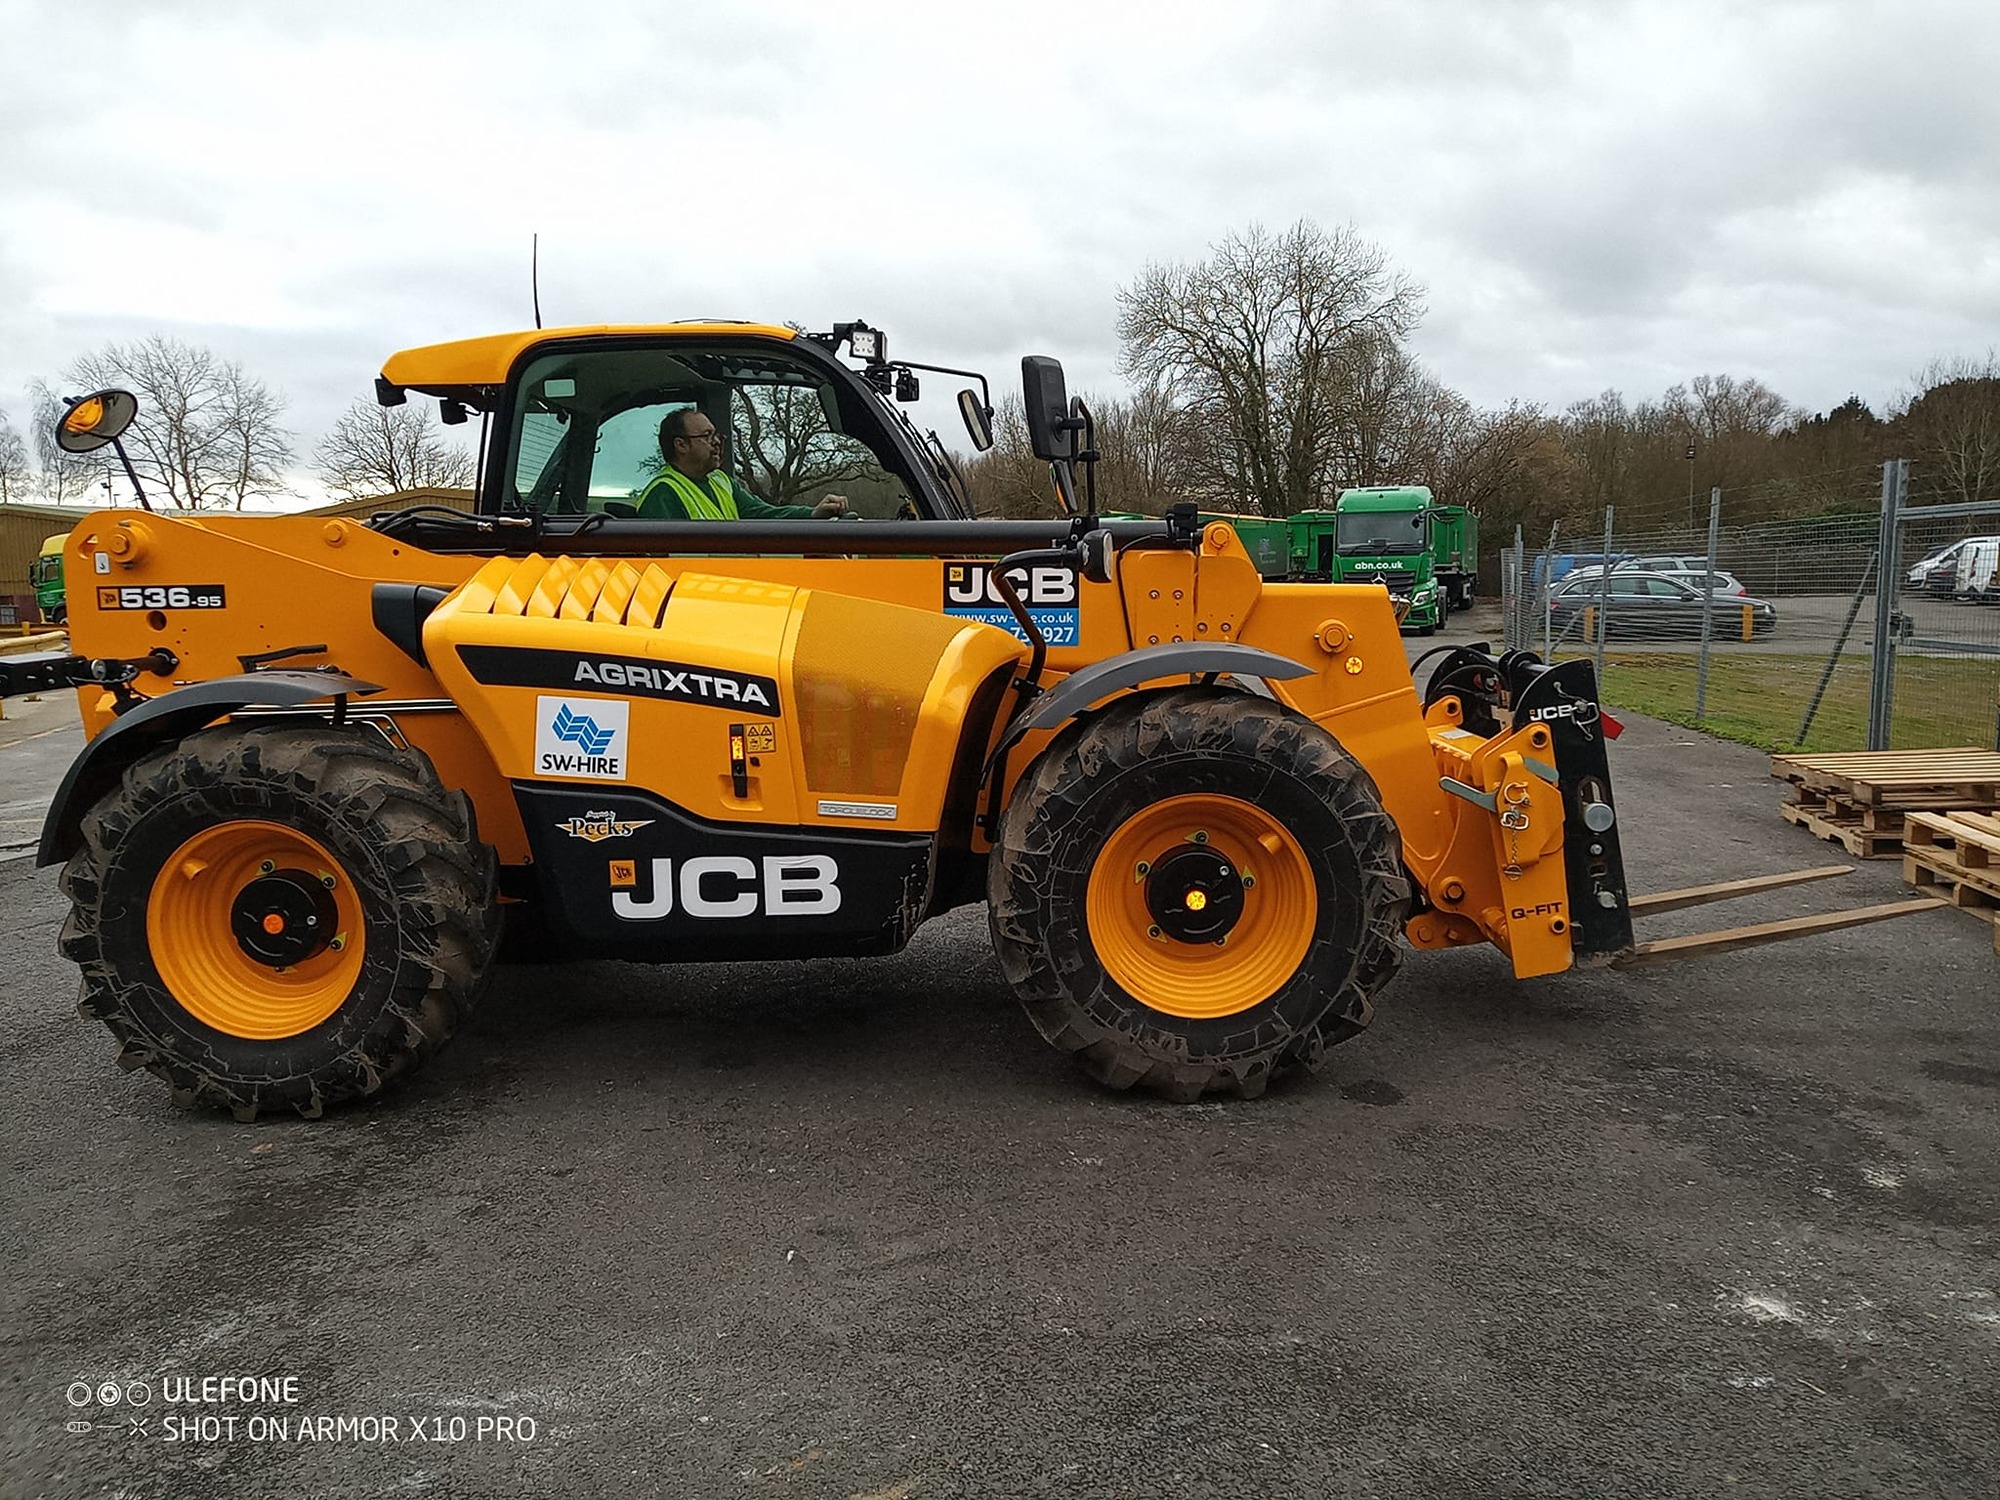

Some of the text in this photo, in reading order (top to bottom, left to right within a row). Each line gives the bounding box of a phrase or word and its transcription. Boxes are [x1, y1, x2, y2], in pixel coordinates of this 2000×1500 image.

[1354, 561, 1404, 570] abn.co.uk
[949, 567, 1075, 603] JCB
[574, 661, 770, 707] AGRIXTRA
[542, 753, 619, 775] SW-HIRE
[569, 818, 632, 837] Pecks
[611, 855, 842, 920] JCB
[1511, 902, 1563, 919] Q-FIT
